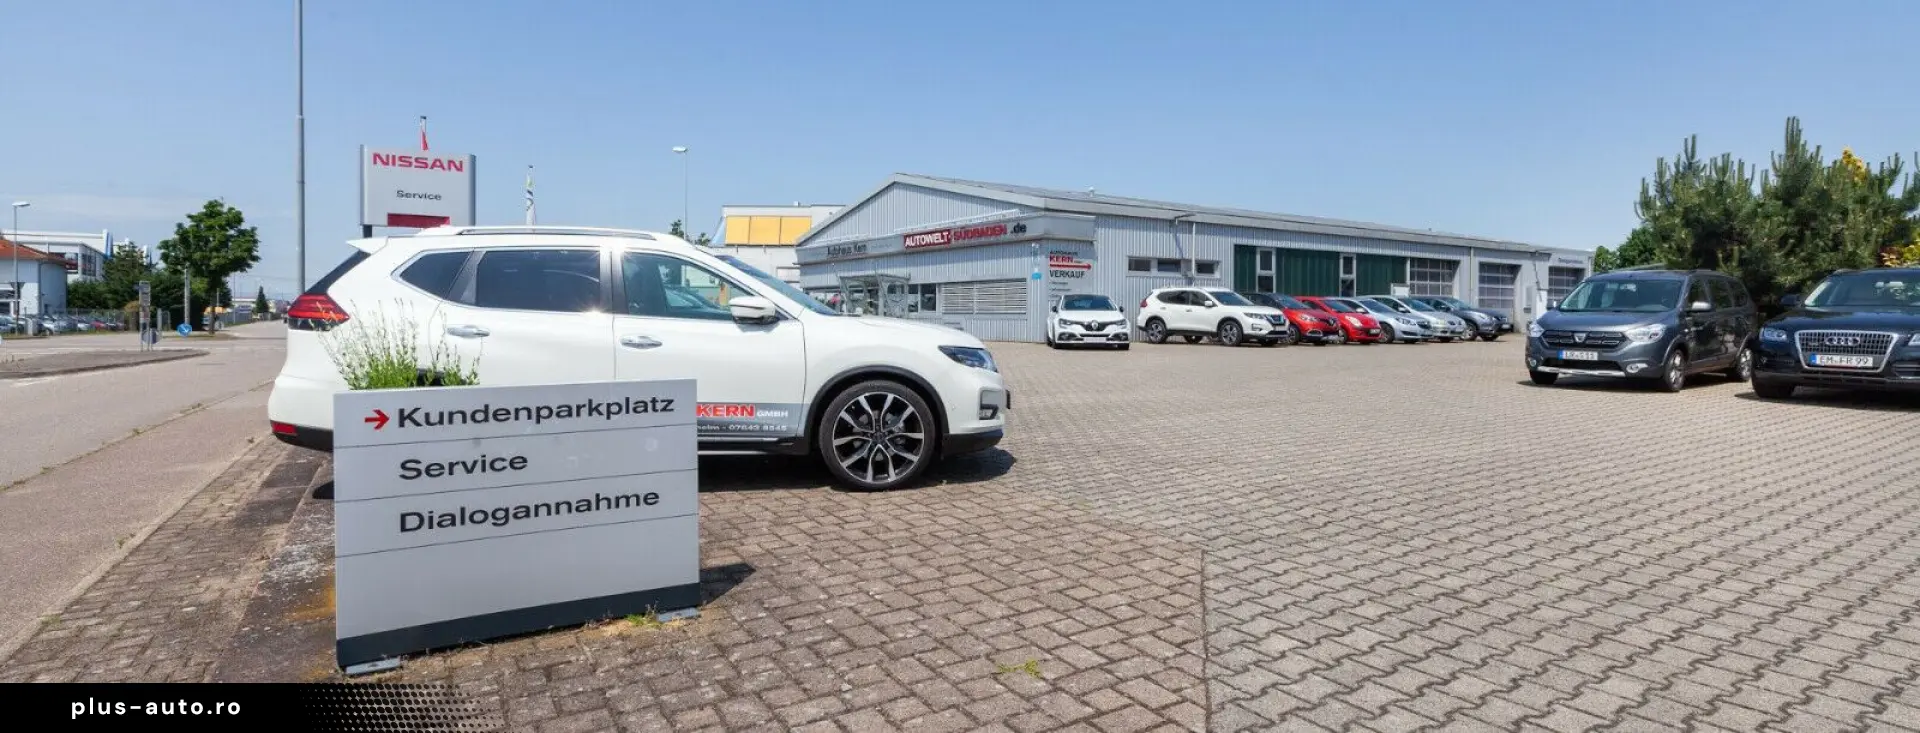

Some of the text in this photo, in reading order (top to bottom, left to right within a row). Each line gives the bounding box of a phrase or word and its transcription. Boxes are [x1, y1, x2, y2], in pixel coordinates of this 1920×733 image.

[372, 152, 464, 172] NISSAN
[396, 189, 442, 201] Service
[1049, 255, 1074, 263] KERN
[1049, 270, 1085, 278] VERKAUF
[397, 397, 675, 429] Kundenparkplatz
[696, 403, 755, 418] KERN
[398, 454, 529, 480] Service
[399, 491, 660, 533] Dialogannahme
